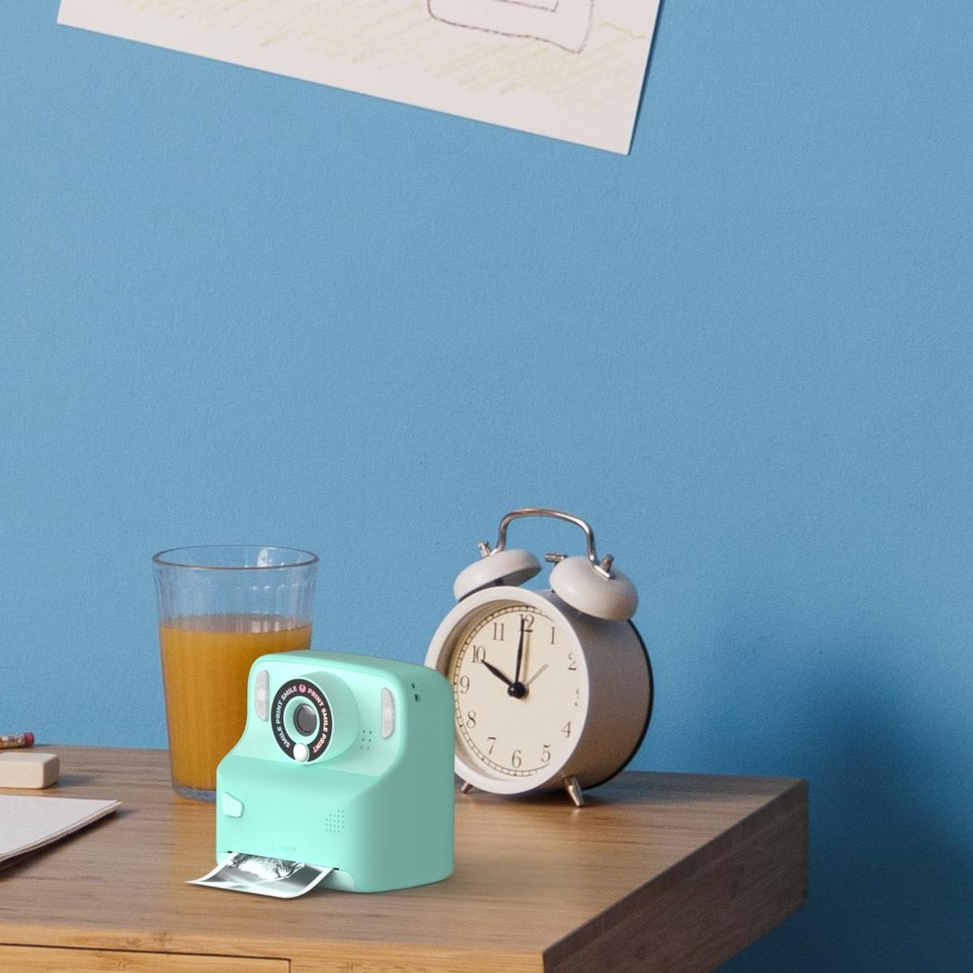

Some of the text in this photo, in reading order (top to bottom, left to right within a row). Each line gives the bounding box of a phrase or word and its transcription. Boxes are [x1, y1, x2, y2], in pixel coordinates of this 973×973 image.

[492, 622, 504, 641] 11
[550, 626, 556, 644] 1
[472, 645, 486, 663] 10
[568, 652, 577, 670] 2
[281, 686, 297, 700] SMILE
[460, 676, 470, 693] 9
[308, 688, 329, 753] PRINT SMILE PRINT
[467, 711, 476, 728] 8
[277, 726, 290, 748] SMILE
[562, 721, 571, 739] 4
[487, 737, 496, 754] 7
[541, 745, 551, 762] 5
[512, 750, 521, 768] 6
